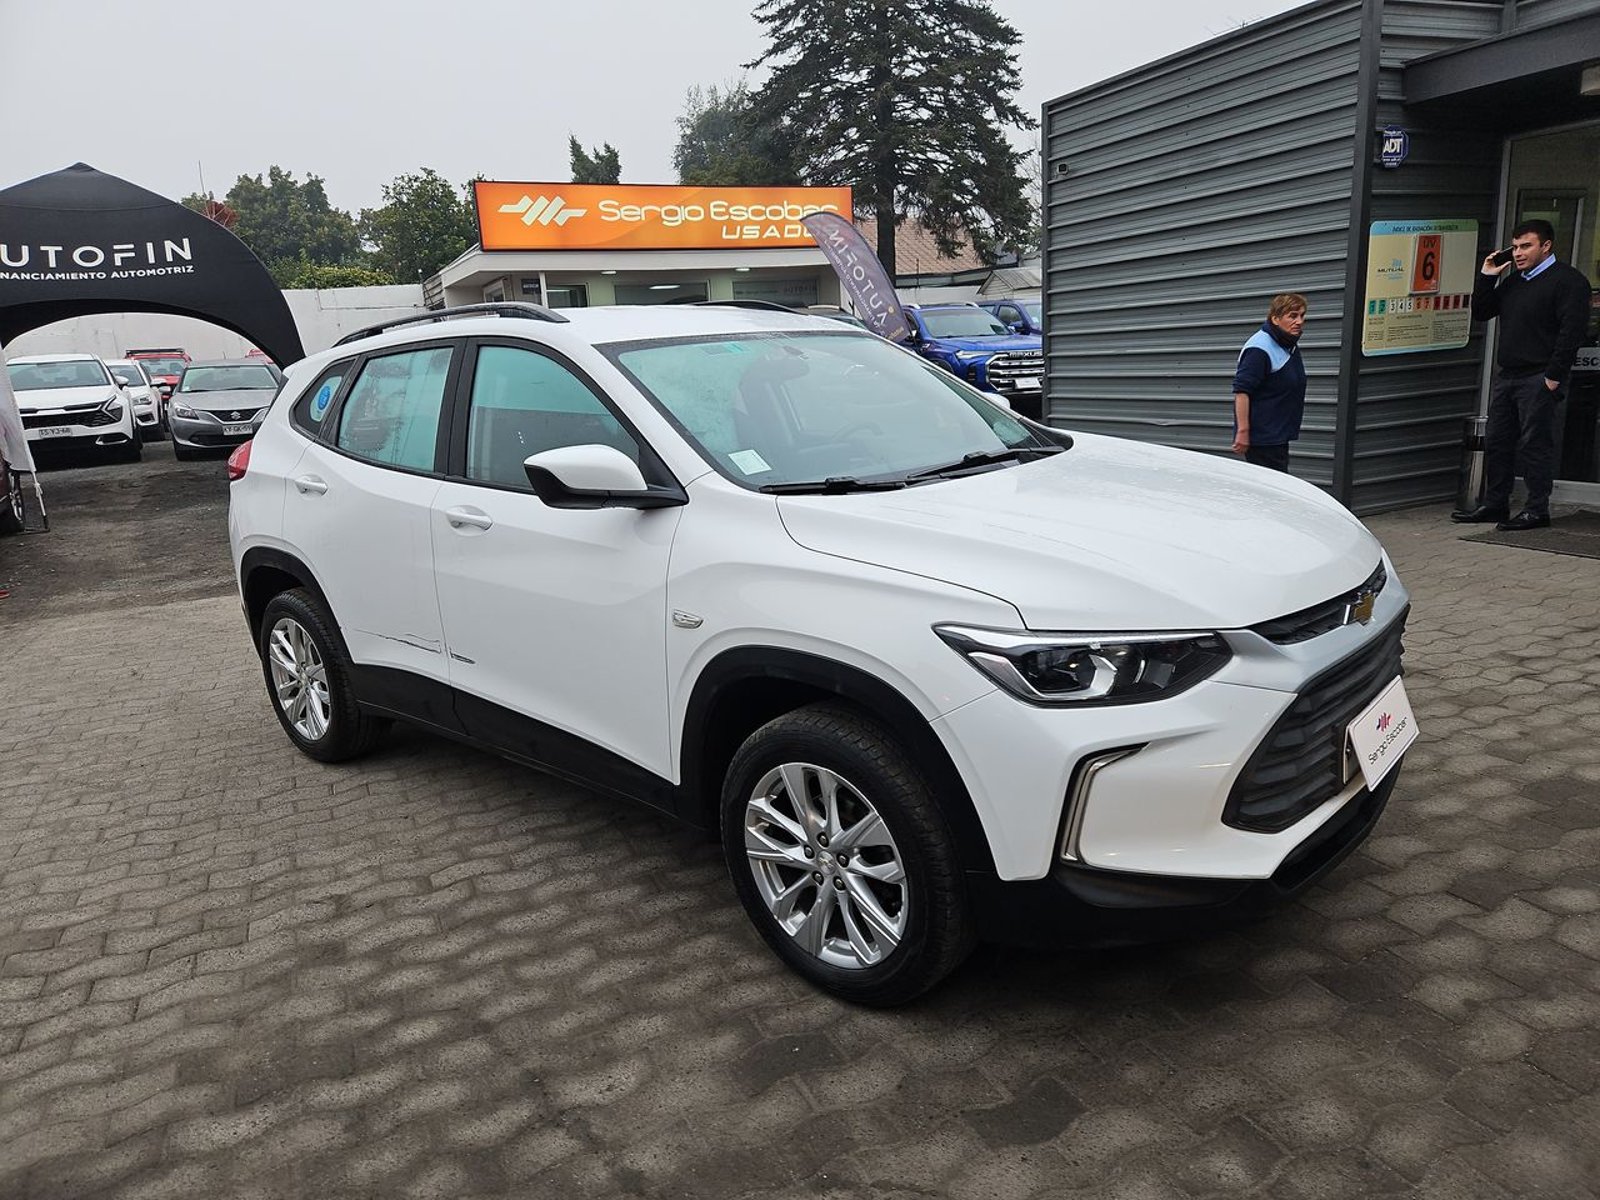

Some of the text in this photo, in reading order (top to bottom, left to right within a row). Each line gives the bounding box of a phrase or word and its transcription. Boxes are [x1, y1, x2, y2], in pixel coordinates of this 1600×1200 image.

[1383, 138, 1403, 153] ADT
[598, 199, 704, 226] Sergio
[0, 238, 192, 268] UTOFIN
[1423, 239, 1437, 249] UV
[111, 265, 195, 279] AUTOMOTRIZ
[1422, 251, 1435, 280] 6
[1368, 716, 1407, 765] Sergio Escobar
